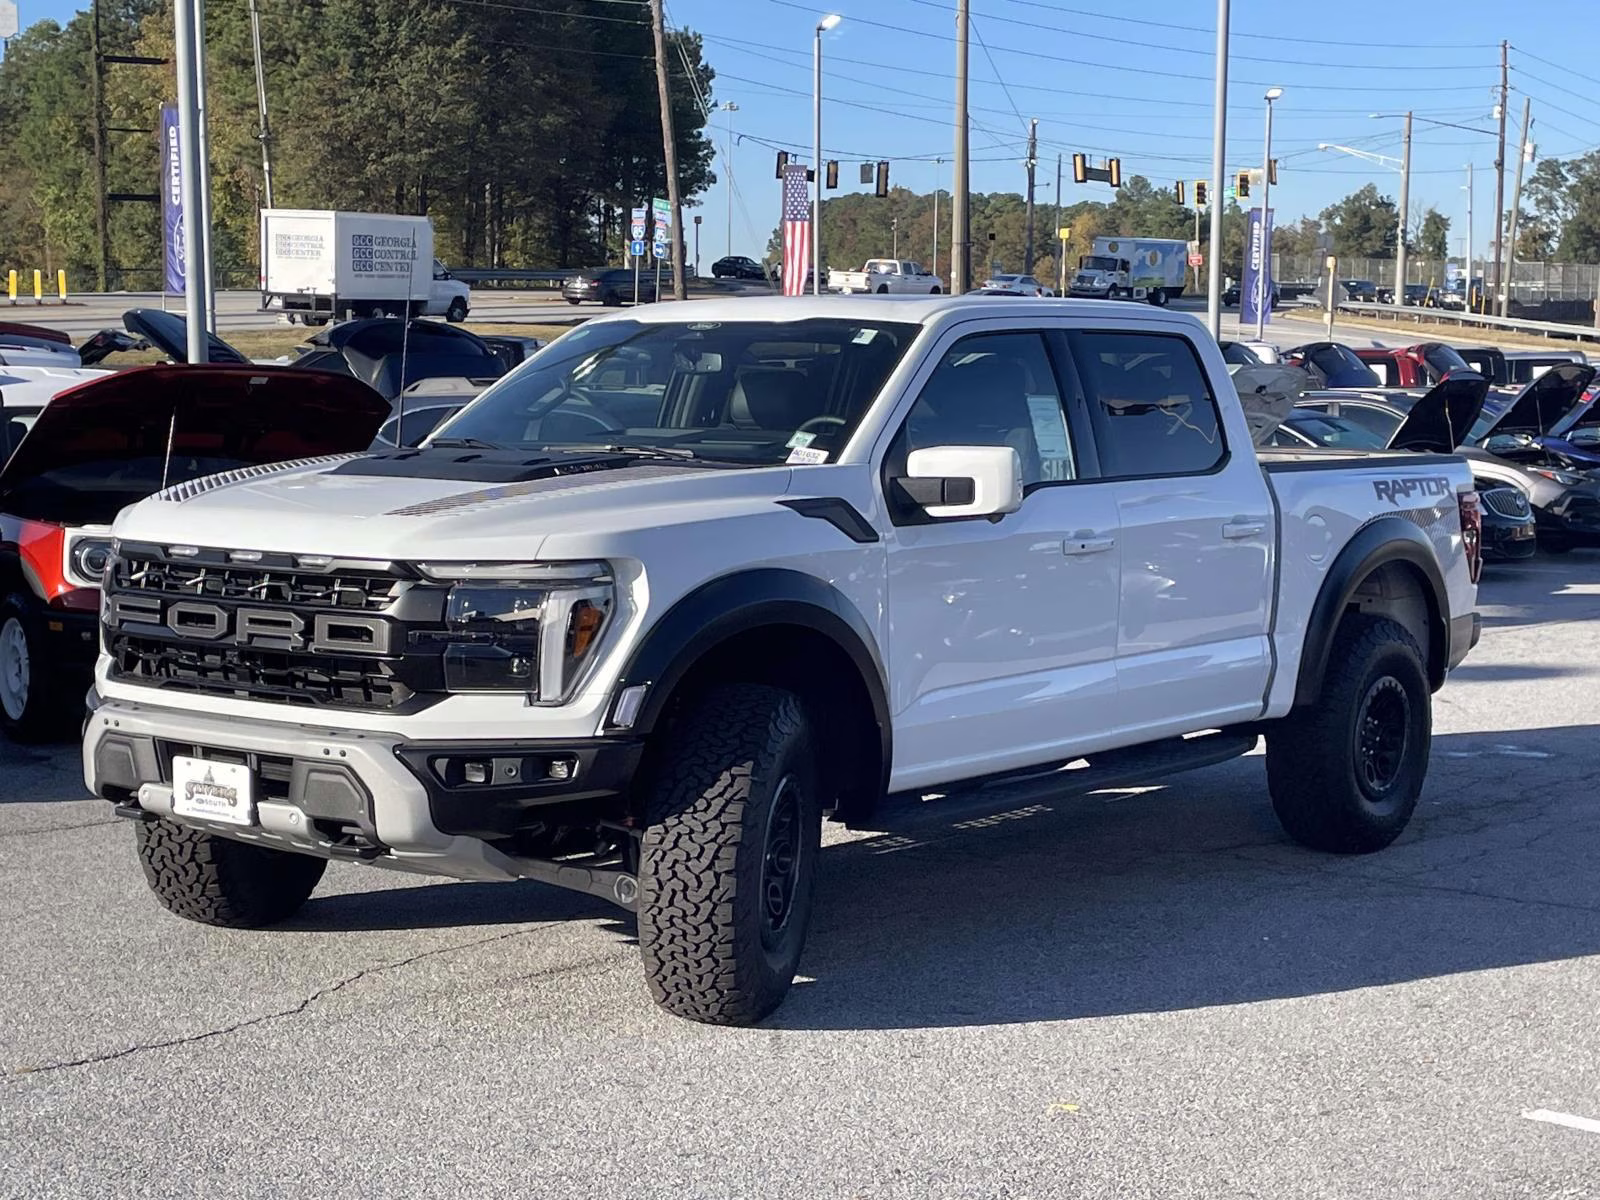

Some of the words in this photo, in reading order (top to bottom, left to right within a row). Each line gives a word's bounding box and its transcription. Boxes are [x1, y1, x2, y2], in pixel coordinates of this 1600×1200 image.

[169, 125, 181, 206] CERTIFIED
[353, 235, 373, 246] GCC
[374, 236, 417, 248] GEORGIA
[353, 247, 373, 259] GCC
[374, 249, 418, 260] CONTROL
[1251, 221, 1262, 270] CERTIFIED
[353, 260, 373, 272] GCC
[1373, 477, 1454, 507] RAPTOR
[108, 595, 391, 654] FORD
